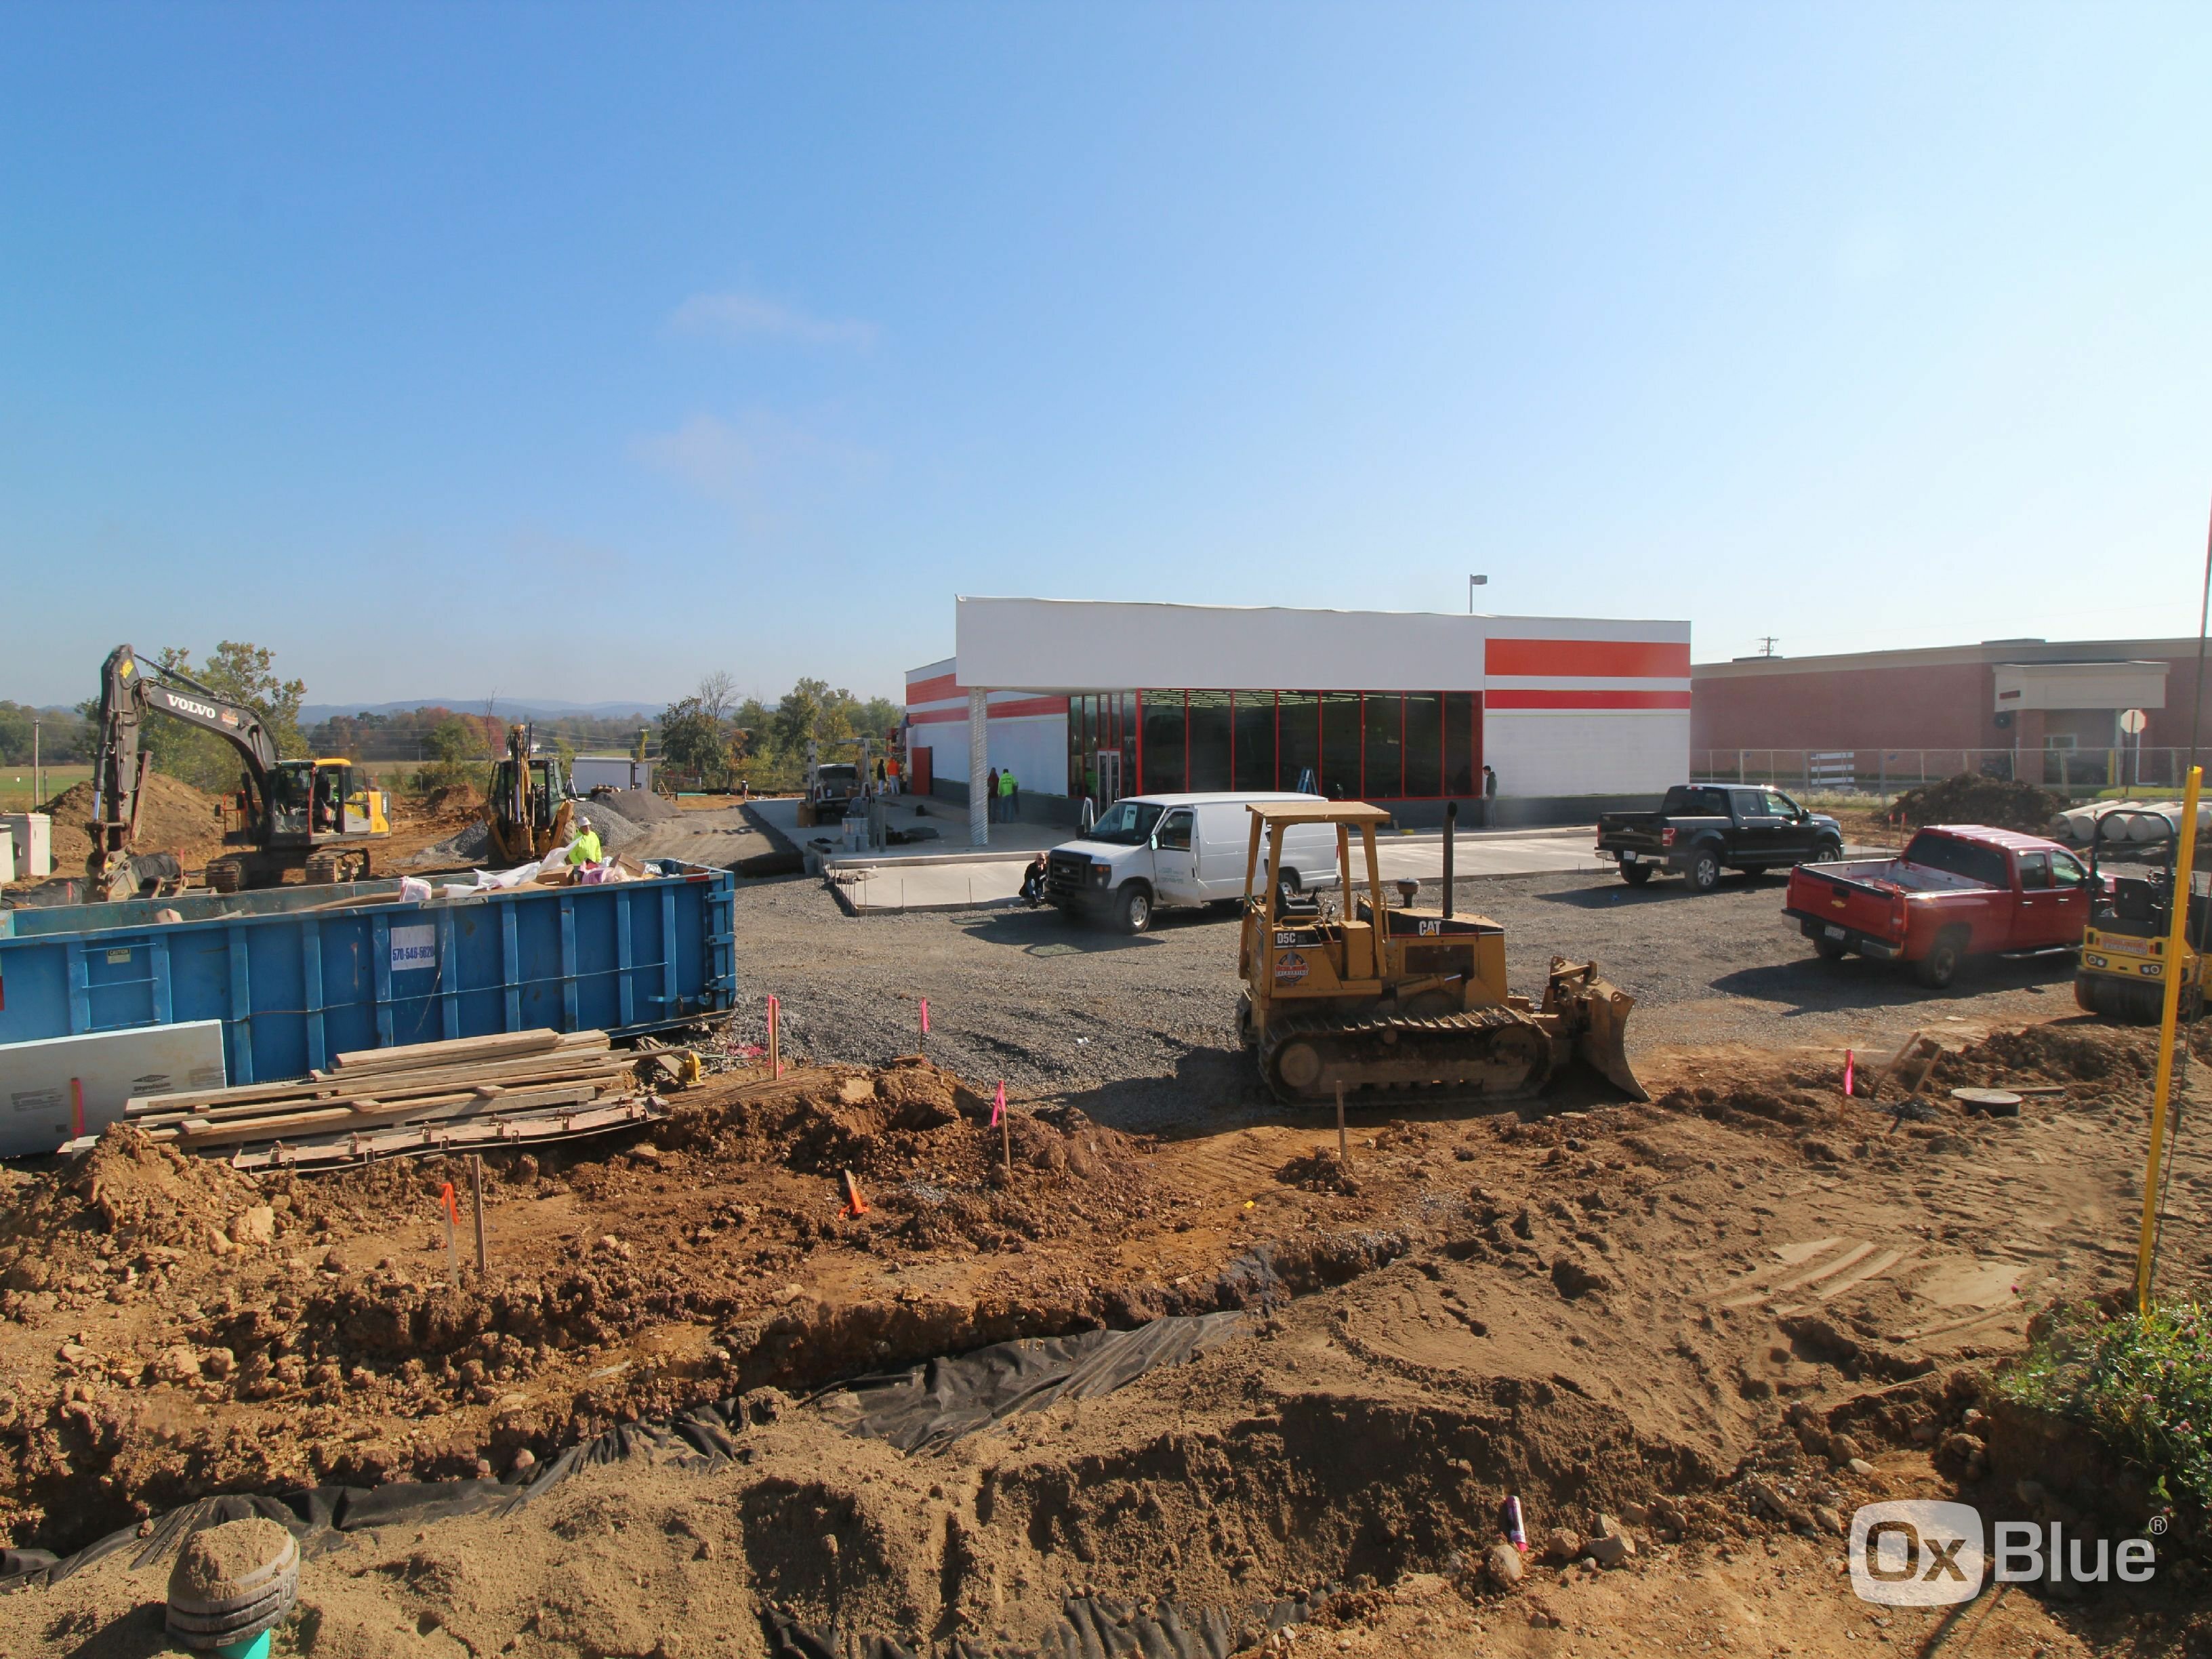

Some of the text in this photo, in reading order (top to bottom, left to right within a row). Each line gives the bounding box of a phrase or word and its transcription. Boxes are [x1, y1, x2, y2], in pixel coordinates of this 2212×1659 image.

[167, 693, 216, 718] VOLVO
[1419, 920, 1441, 937] CAT
[1277, 933, 1296, 943] D5C
